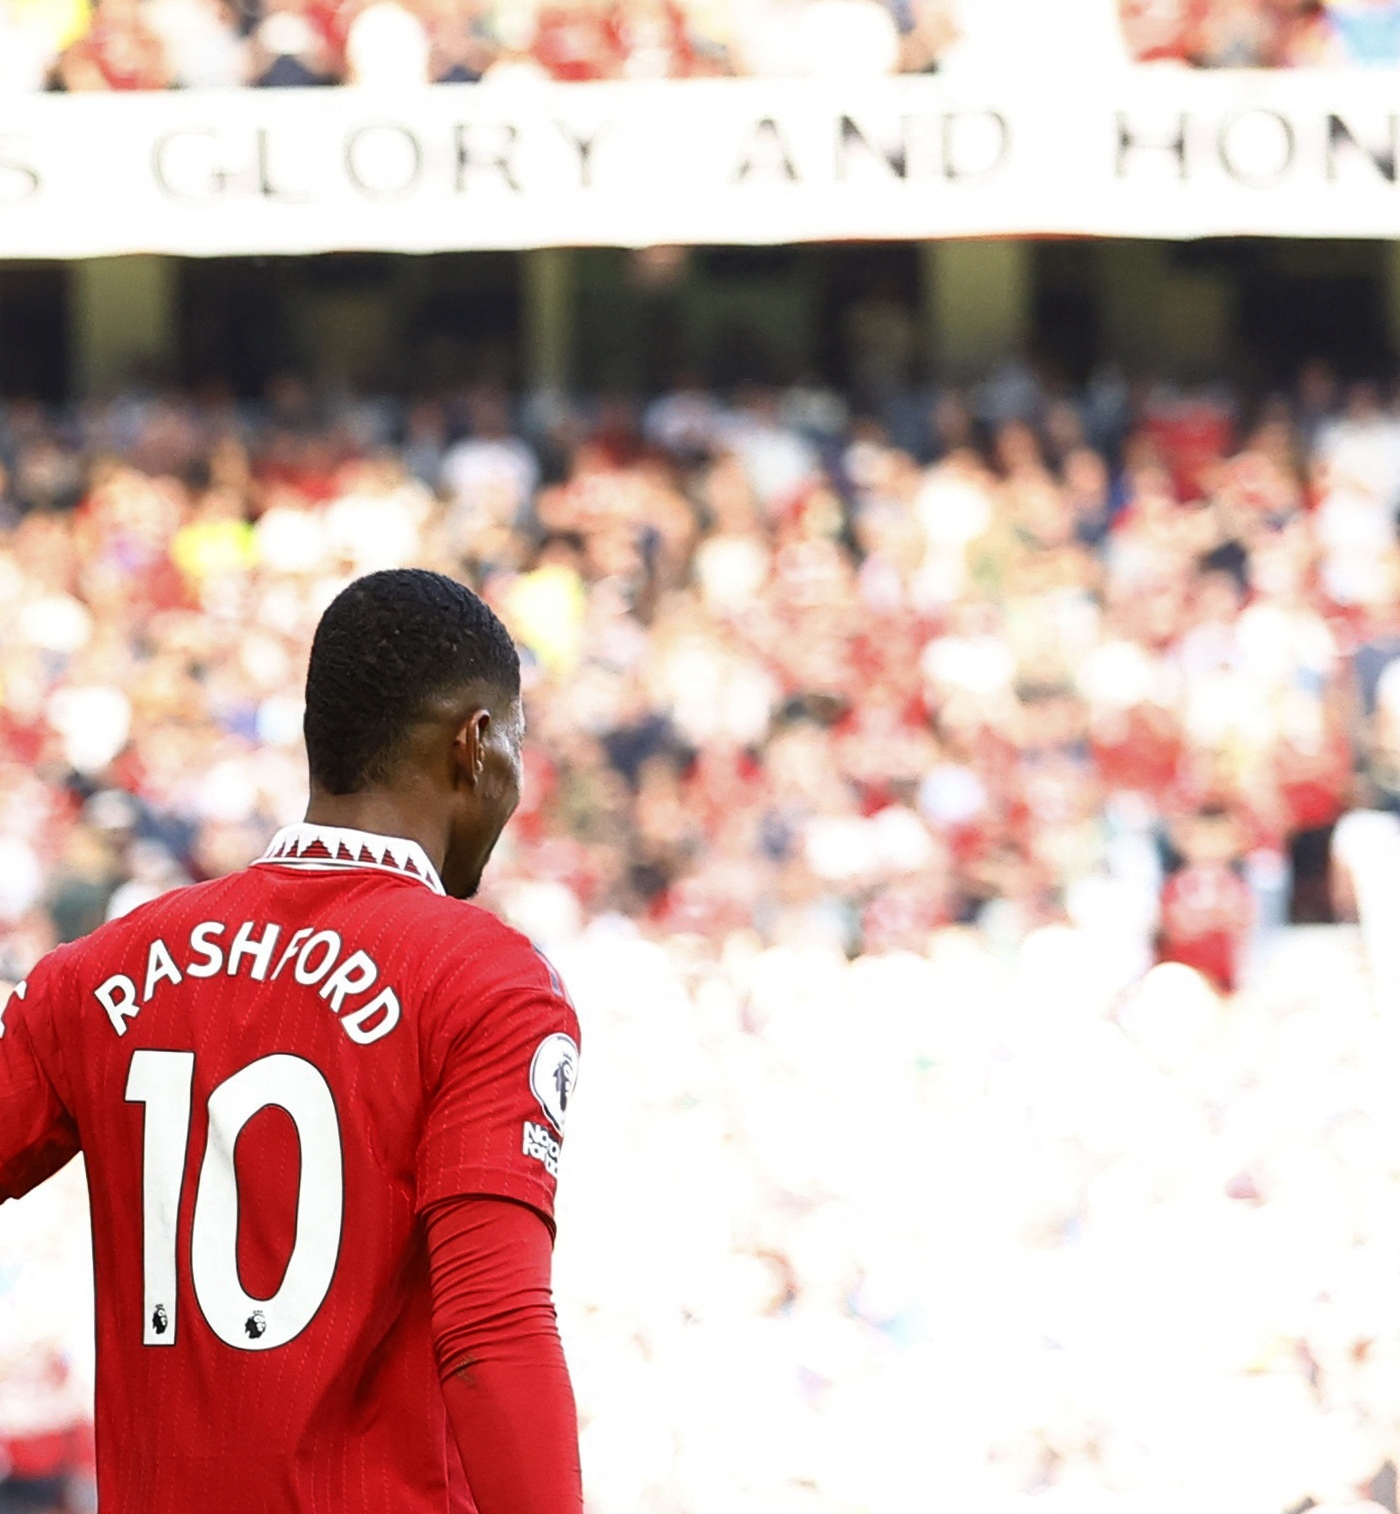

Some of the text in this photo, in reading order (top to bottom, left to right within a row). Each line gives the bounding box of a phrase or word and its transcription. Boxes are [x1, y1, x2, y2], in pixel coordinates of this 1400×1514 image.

[149, 114, 619, 208] GLORY
[726, 106, 1015, 187] AND
[1111, 105, 1400, 190] HON
[94, 919, 401, 1046] RASHFORD
[123, 1048, 345, 1352] 10
